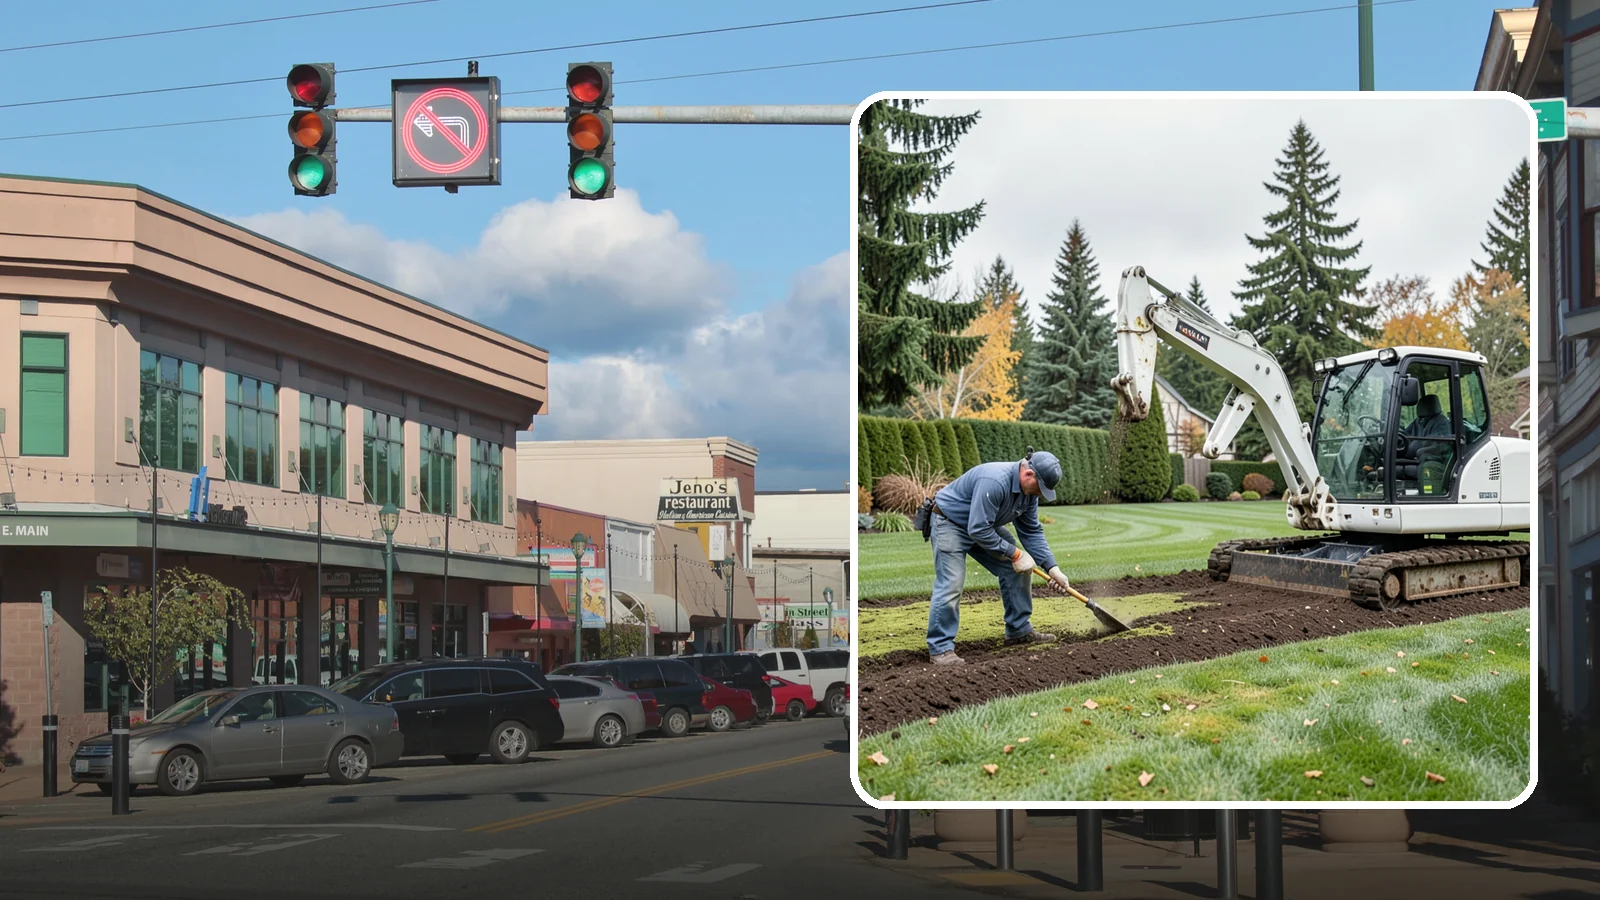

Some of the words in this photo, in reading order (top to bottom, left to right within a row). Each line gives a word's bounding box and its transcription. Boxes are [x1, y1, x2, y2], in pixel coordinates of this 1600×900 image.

[669, 480, 728, 495] Jeno's
[665, 496, 731, 509] restaurant
[658, 509, 682, 519] Italian
[686, 509, 715, 519] American
[715, 509, 738, 519] Cuisine
[2, 525, 13, 536] E.
[15, 525, 49, 537] MAIN
[797, 607, 828, 617] Street
[791, 619, 823, 627] lass
